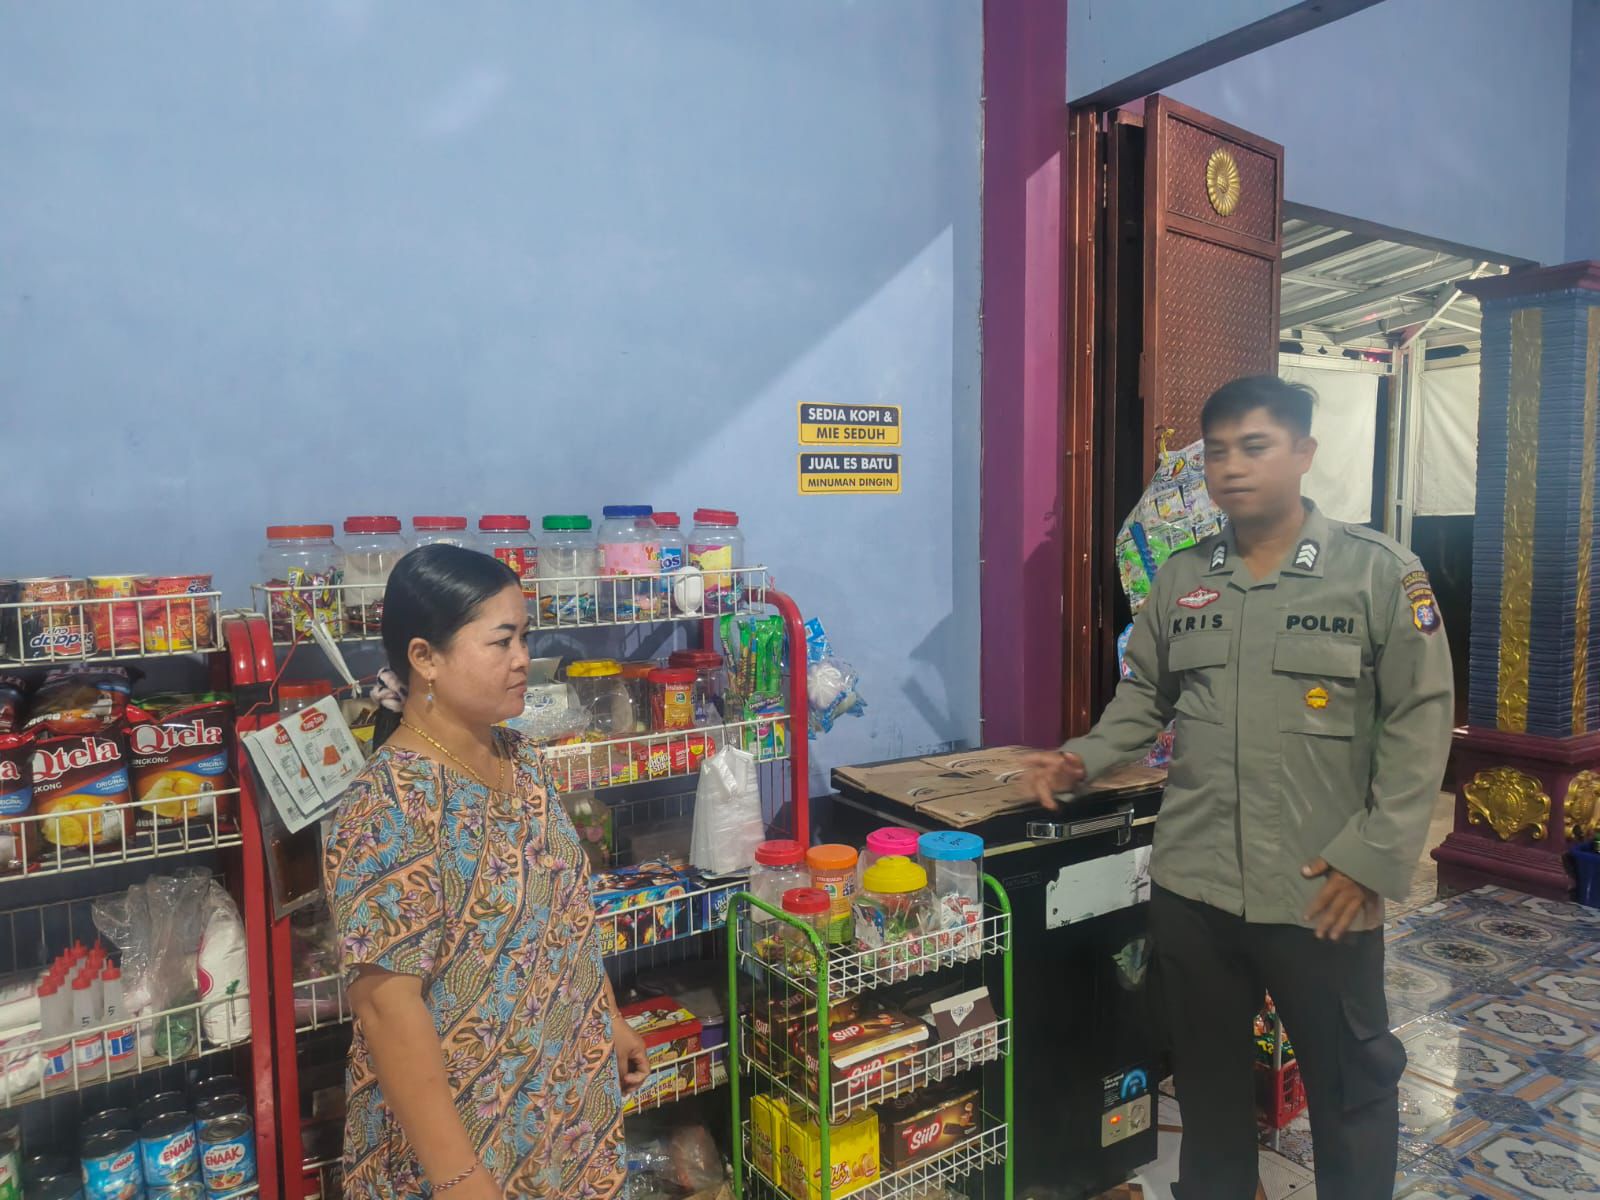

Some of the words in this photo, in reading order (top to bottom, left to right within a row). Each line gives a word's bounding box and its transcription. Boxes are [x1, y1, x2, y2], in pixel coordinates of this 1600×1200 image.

[808, 408, 846, 421] SEDIA
[850, 410, 879, 422] KOPI
[884, 411, 892, 422] &
[816, 427, 839, 439] MIE
[844, 428, 885, 440] SEDUH
[808, 457, 840, 470] JUAL
[843, 458, 857, 470] ES
[861, 458, 892, 470] BATU
[808, 478, 856, 487] MINUMAN
[859, 478, 893, 487] DINGIN
[1172, 614, 1223, 634] KRIS
[1286, 615, 1354, 634] POLRI
[130, 719, 223, 755] Qtela
[33, 736, 121, 783] Qtela
[162, 1135, 194, 1162] ENAAK
[205, 1146, 242, 1167] ENAAK
